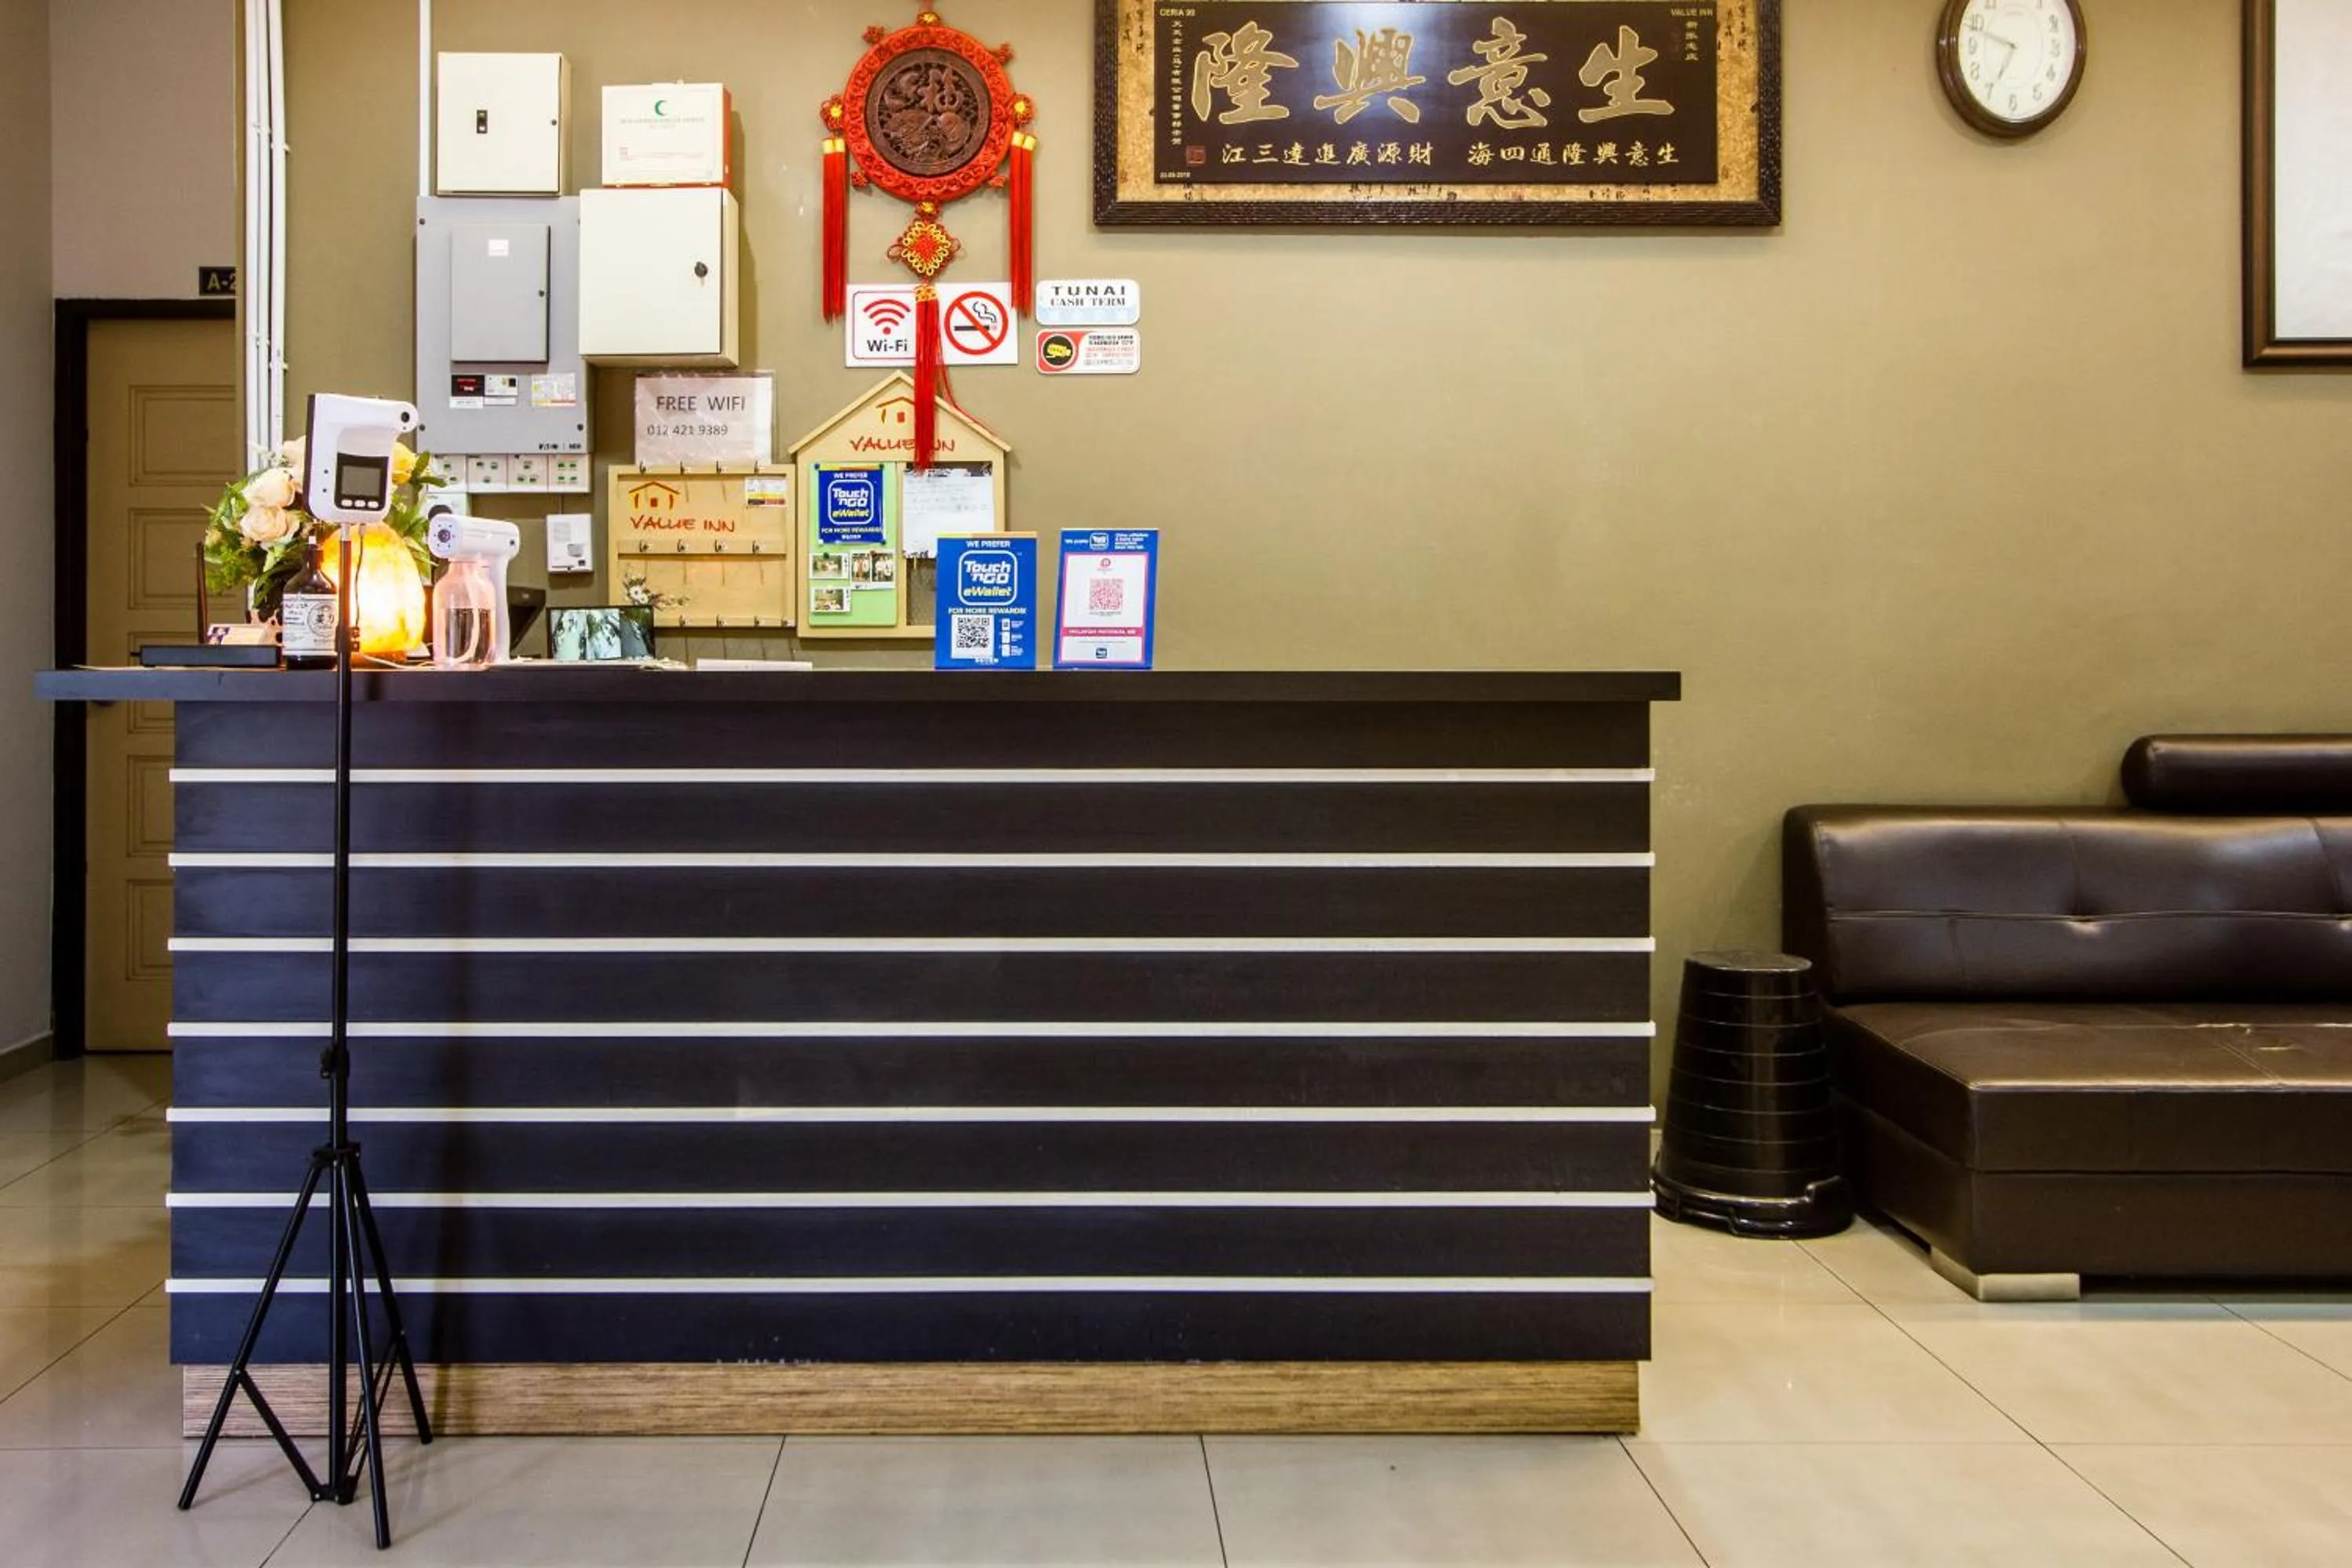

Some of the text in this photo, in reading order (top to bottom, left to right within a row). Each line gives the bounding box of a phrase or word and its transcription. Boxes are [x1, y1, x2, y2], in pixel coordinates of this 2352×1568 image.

[1968, 37, 1978, 55] 9
[1969, 62, 1980, 81] 8
[2045, 63, 2056, 82] 4
[1984, 82, 1994, 100] 7
[1051, 285, 1126, 296] TUNAI
[1051, 297, 1126, 307] CASH TERM
[867, 339, 909, 352] Wi-Fi
[656, 395, 746, 411] FREE WIFI
[647, 424, 728, 437] 012 421 9389
[849, 436, 916, 452] VALUE
[832, 487, 869, 498] Touch
[630, 514, 735, 532] VALUE INN
[964, 561, 1011, 573] Touch
[964, 586, 1012, 597] eWallet
